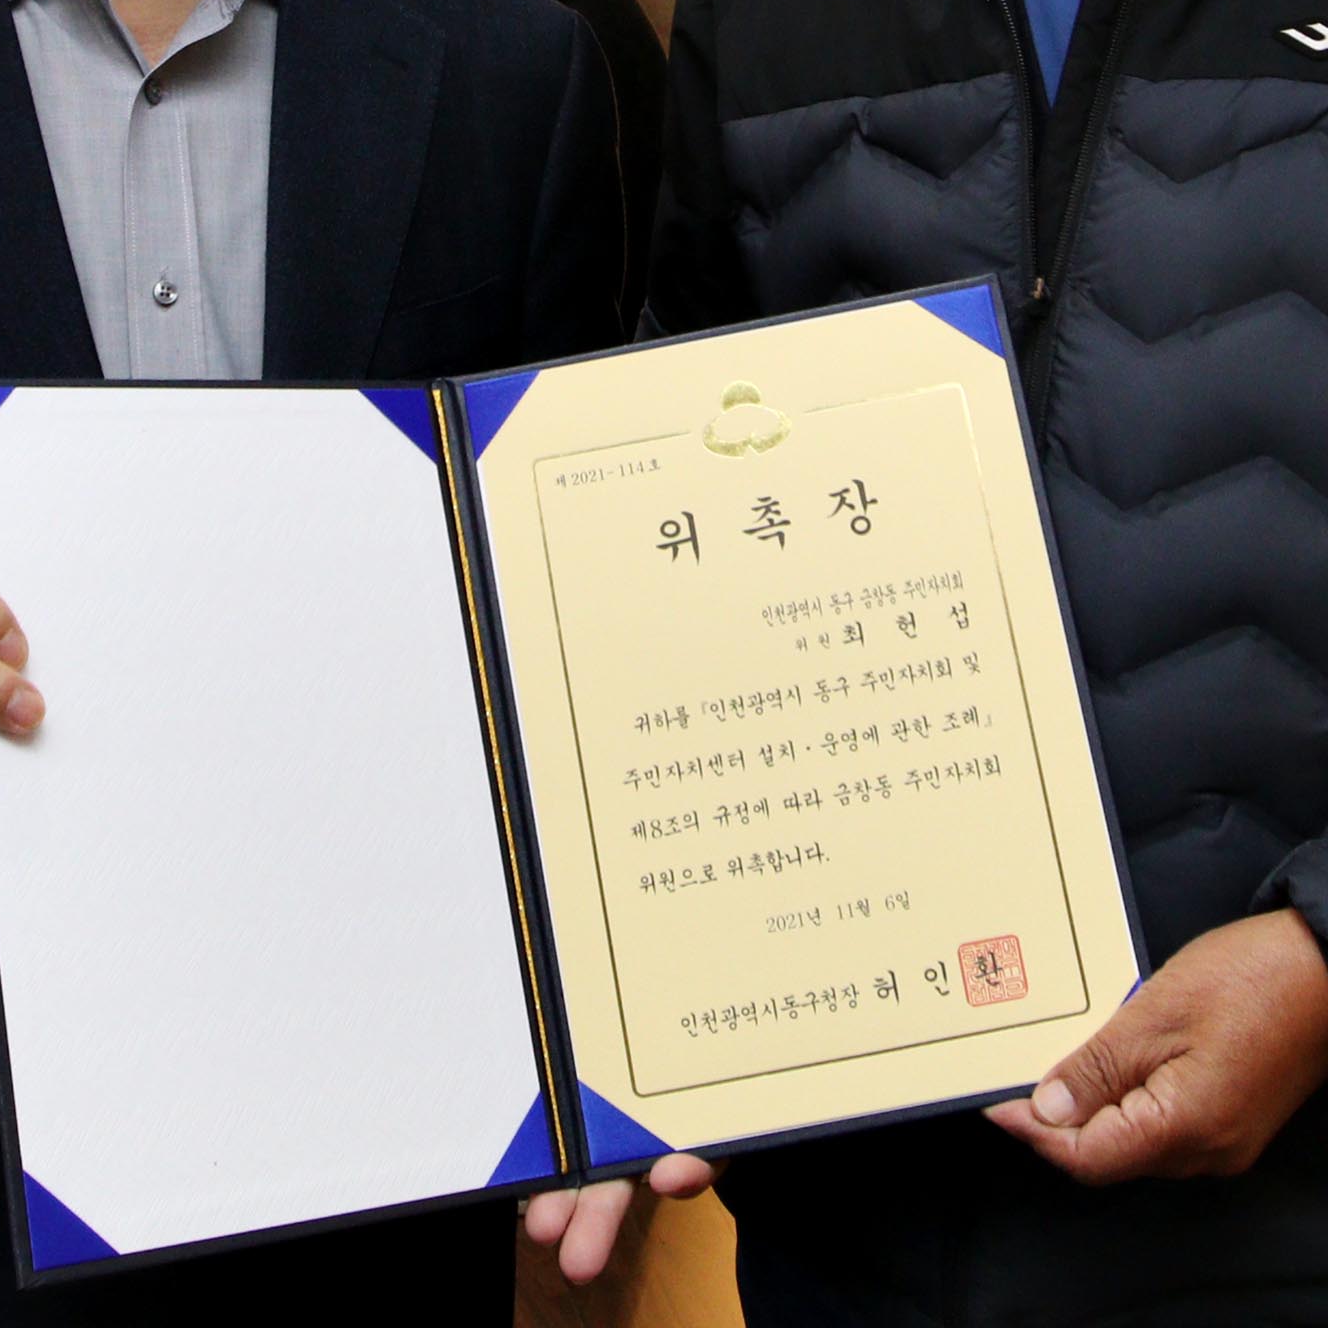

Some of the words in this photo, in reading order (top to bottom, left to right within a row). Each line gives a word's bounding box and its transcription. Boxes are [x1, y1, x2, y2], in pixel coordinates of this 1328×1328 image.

[761, 596, 824, 628] 인천광역시
[829, 591, 854, 615] 동구
[903, 570, 964, 598] 주민자치회
[634, 705, 690, 736] 귀하를
[813, 676, 851, 704] 동구
[860, 656, 953, 694] 주민자치회
[962, 651, 982, 675] 및
[623, 748, 746, 791] 주민자치센터
[758, 739, 796, 768] 설치
[820, 724, 881, 757] 운영에
[890, 715, 932, 743] 관한
[631, 810, 700, 843] 제8조의
[712, 797, 770, 828] 규정에
[783, 788, 823, 814] 따라
[833, 774, 892, 807] 금창동
[904, 754, 1002, 792] 주민자치회
[639, 863, 718, 895] 위원으로
[727, 841, 831, 880] 위촉합니다.
[766, 907, 822, 934] 2021년
[836, 897, 871, 921] 11월
[884, 890, 912, 912] 6일
[680, 982, 861, 1039] 인천광역시동구청장
